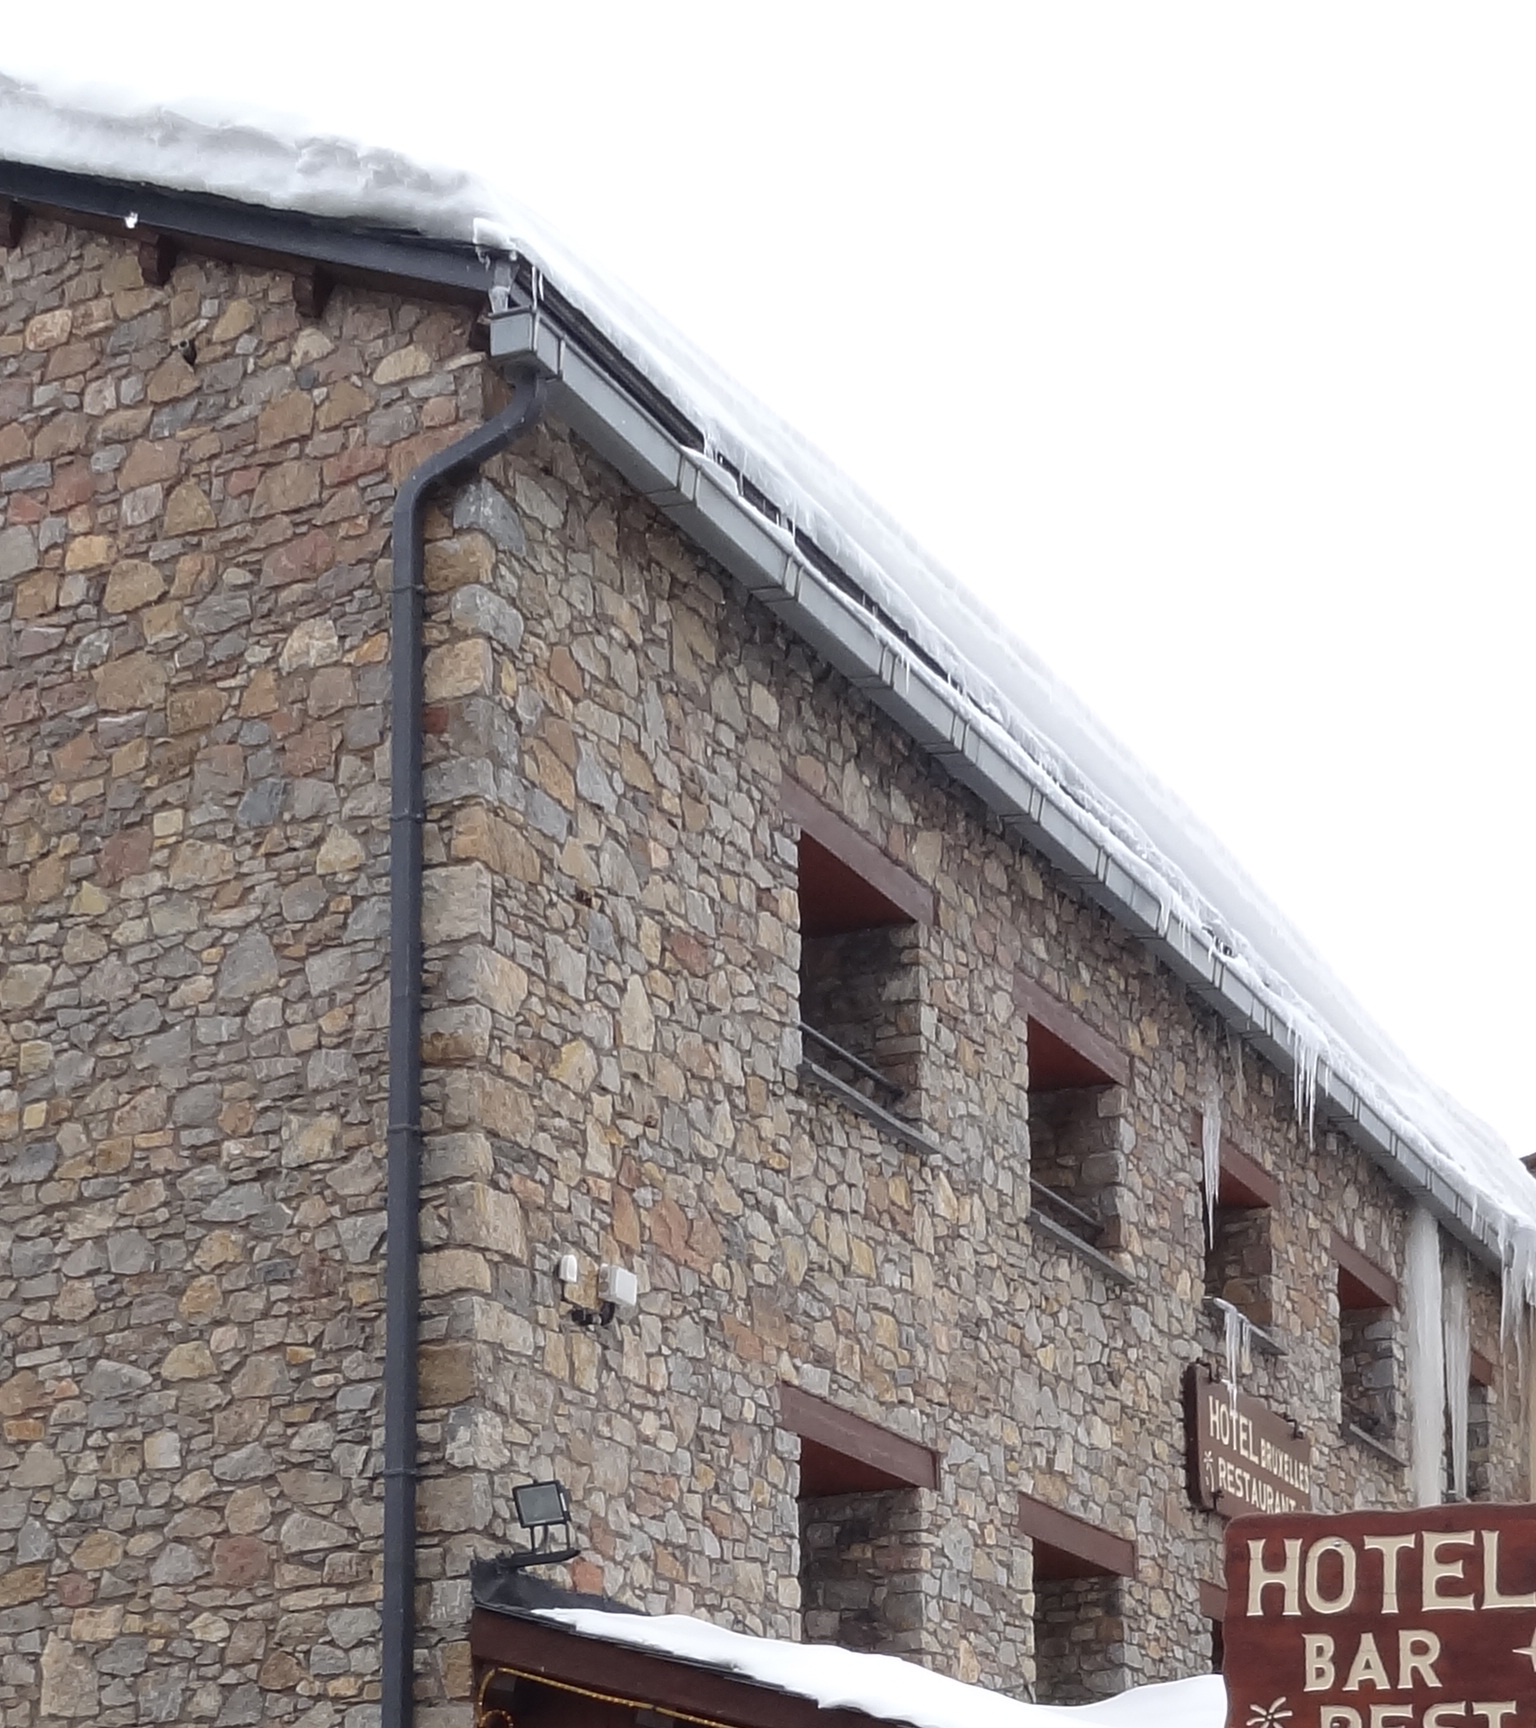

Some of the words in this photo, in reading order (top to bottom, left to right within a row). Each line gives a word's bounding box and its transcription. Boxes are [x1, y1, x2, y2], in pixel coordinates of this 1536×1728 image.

[1208, 1395, 1259, 1464] HOTEL
[1260, 1438, 1310, 1494] BRUXELLES
[1218, 1457, 1296, 1514] RESTAURANT
[1302, 1628, 1443, 1692] BAR
